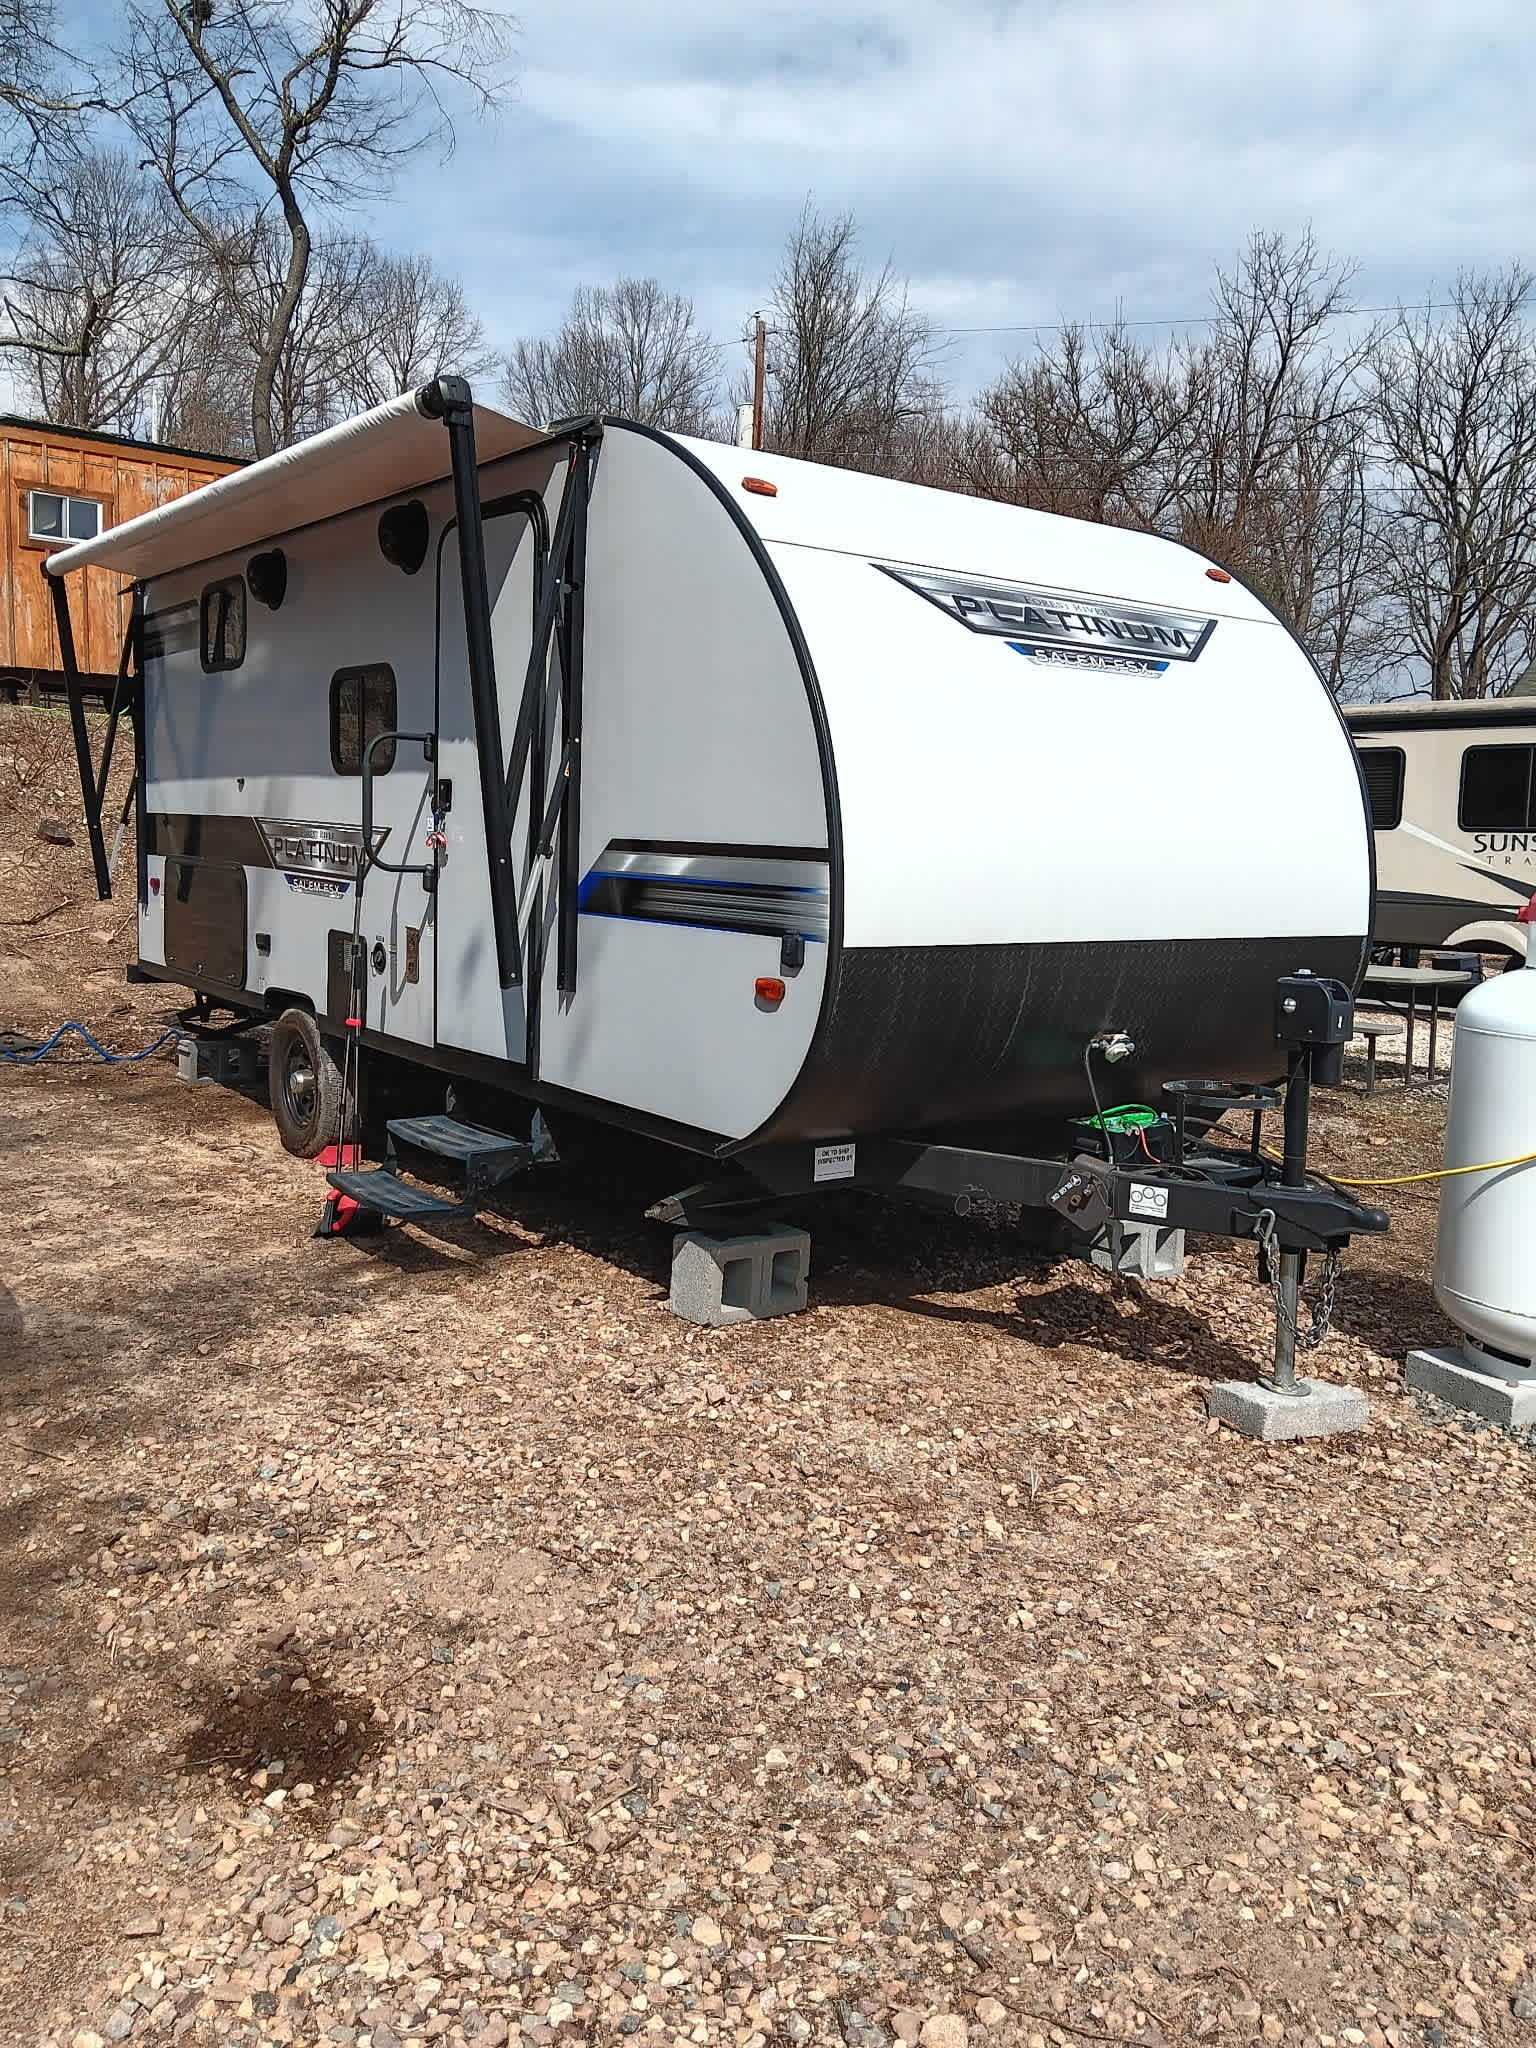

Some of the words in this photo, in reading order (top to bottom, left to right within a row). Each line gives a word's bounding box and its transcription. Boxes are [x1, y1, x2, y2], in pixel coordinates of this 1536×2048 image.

[952, 594, 1192, 650] PLATINUM
[1034, 649, 1109, 669] SALEM
[274, 837, 368, 866] PLATINUM
[293, 878, 321, 891] SALEM
